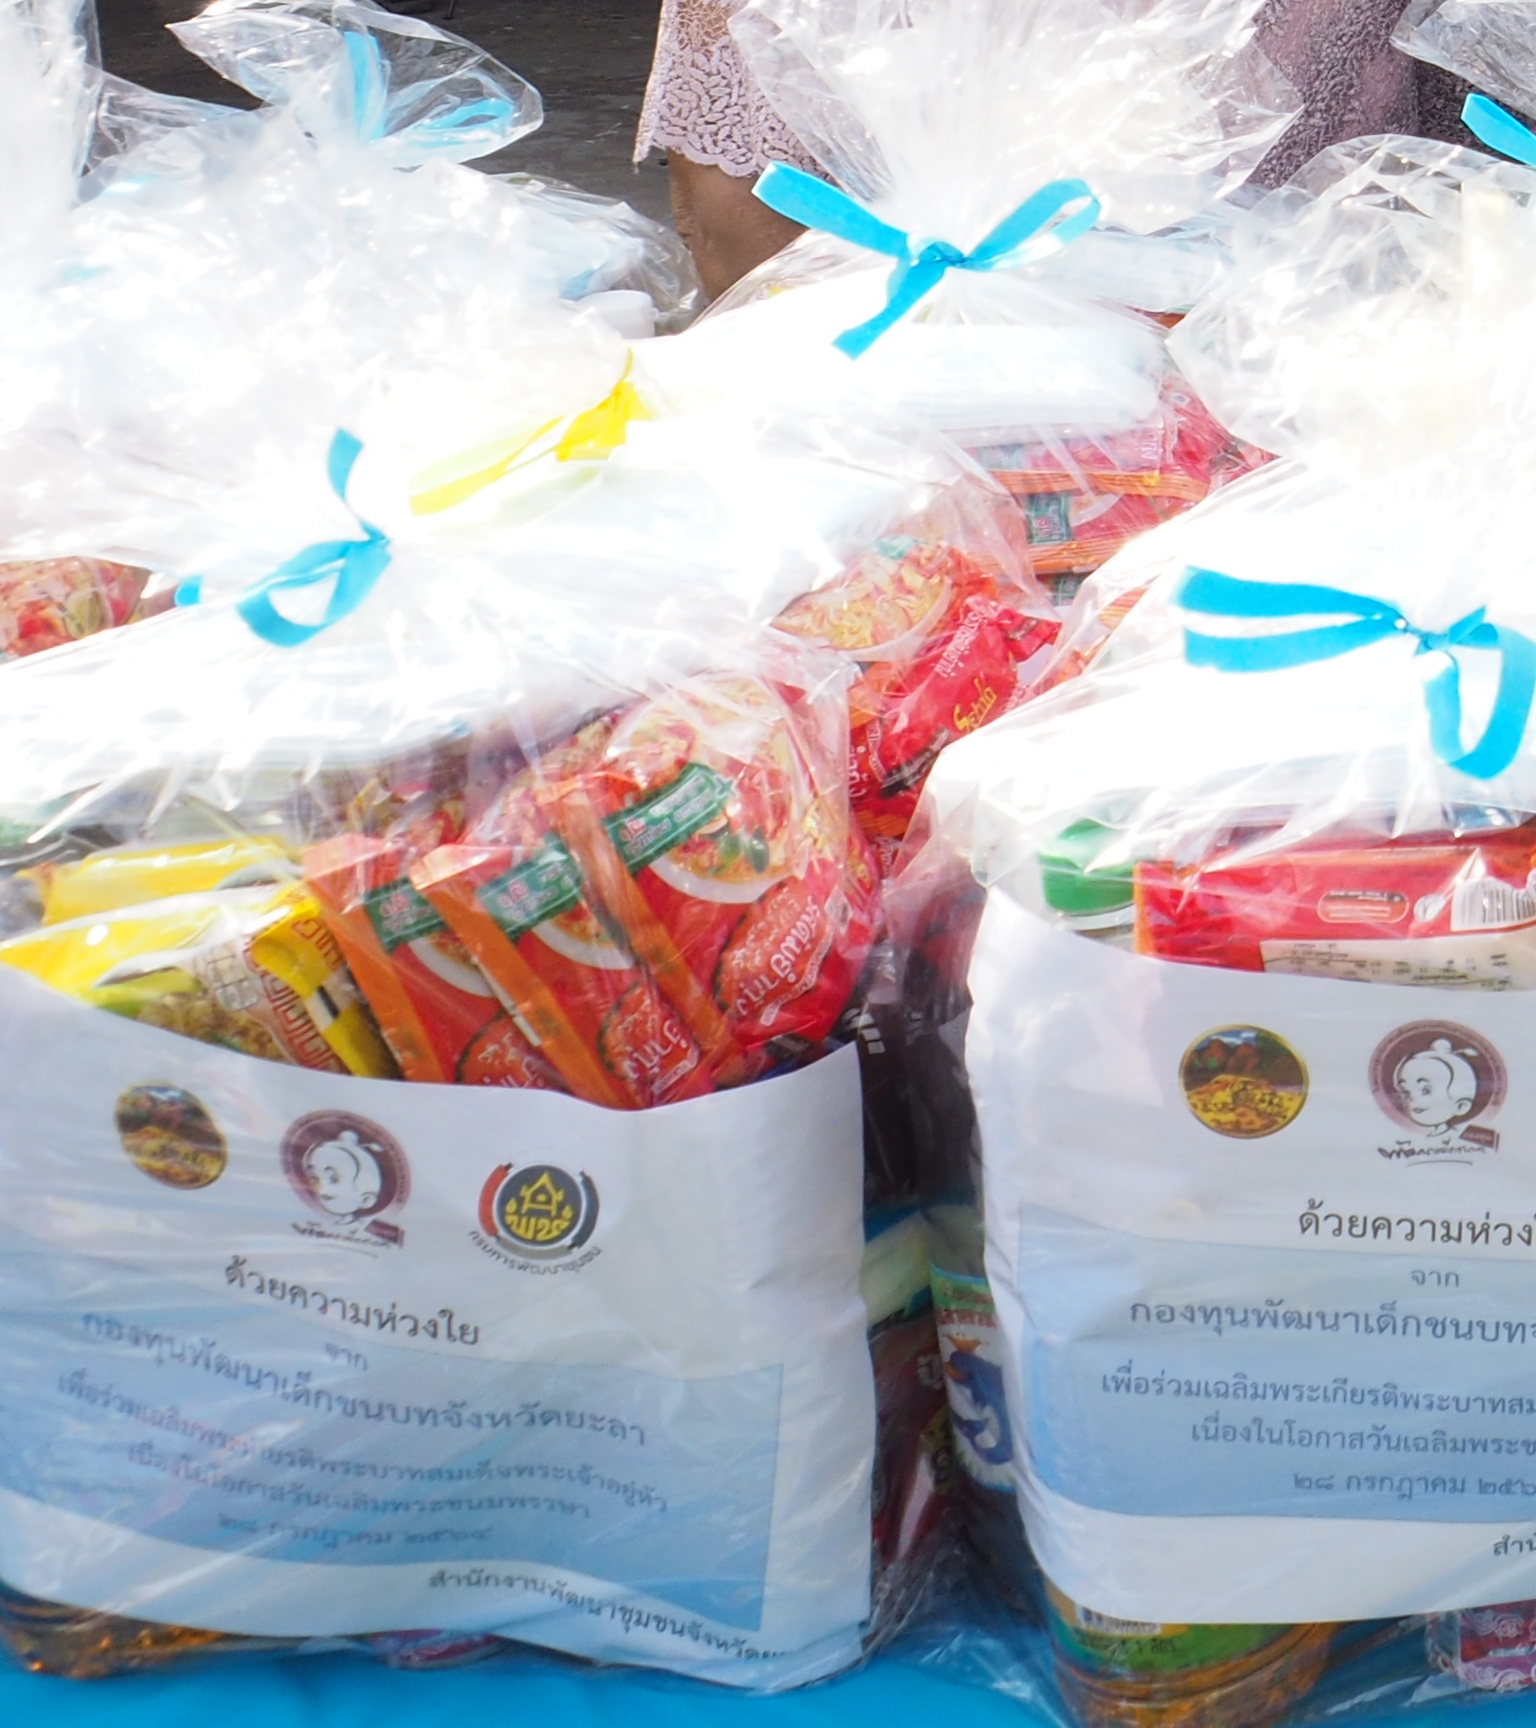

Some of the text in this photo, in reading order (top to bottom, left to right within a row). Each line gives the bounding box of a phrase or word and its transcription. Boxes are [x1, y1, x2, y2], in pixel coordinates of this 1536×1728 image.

[1410, 1268, 1460, 1289] จาก
[225, 1254, 480, 1345] ด้วยความห่วงใย
[325, 1340, 369, 1371] จาก
[82, 1312, 646, 1445] กองทุนพัฒนาเด็กชนบทจังหวัดยะลา
[1293, 1471, 1335, 1494] ๒๘
[1345, 1472, 1466, 1501] กรกฎาคม
